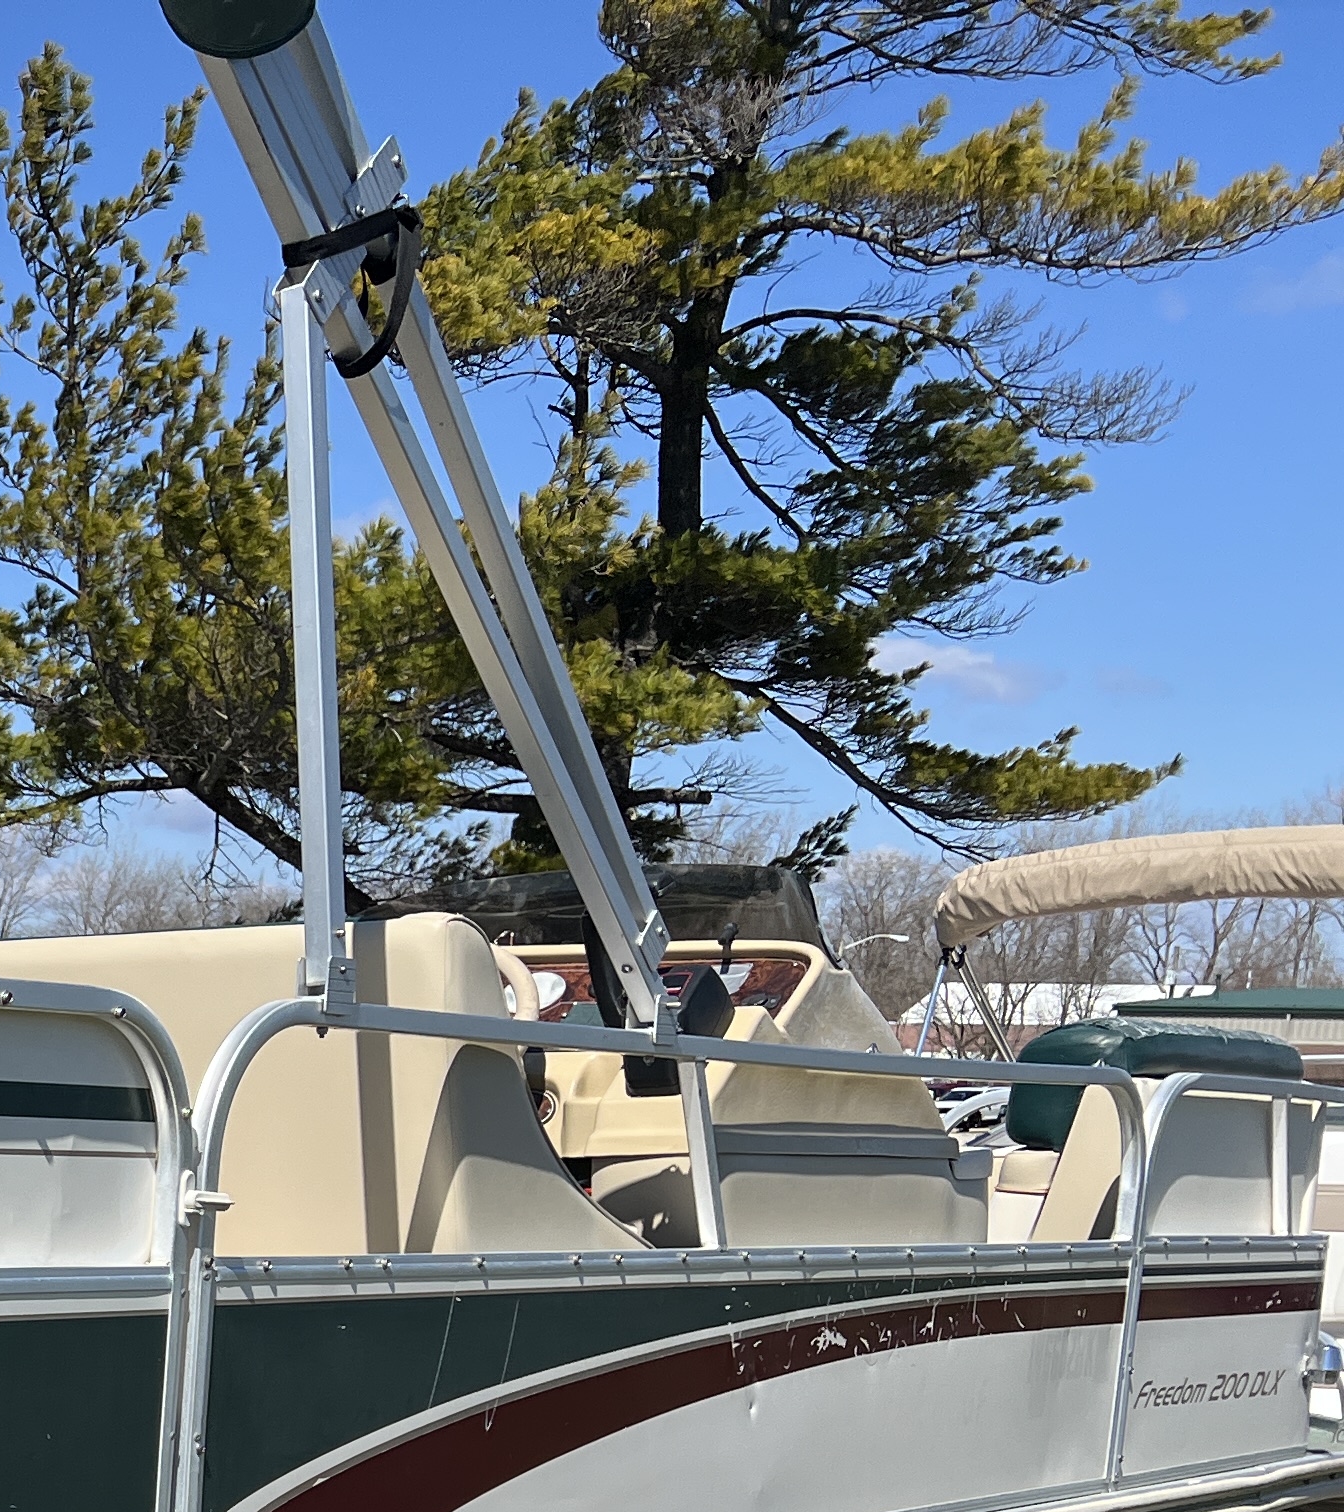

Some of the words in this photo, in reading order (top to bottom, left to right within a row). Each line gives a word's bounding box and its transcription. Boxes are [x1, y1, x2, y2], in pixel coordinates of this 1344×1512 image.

[1133, 1377, 1208, 1410] Freedom
[1208, 1372, 1250, 1402] 200
[1248, 1369, 1287, 1398] DLX
